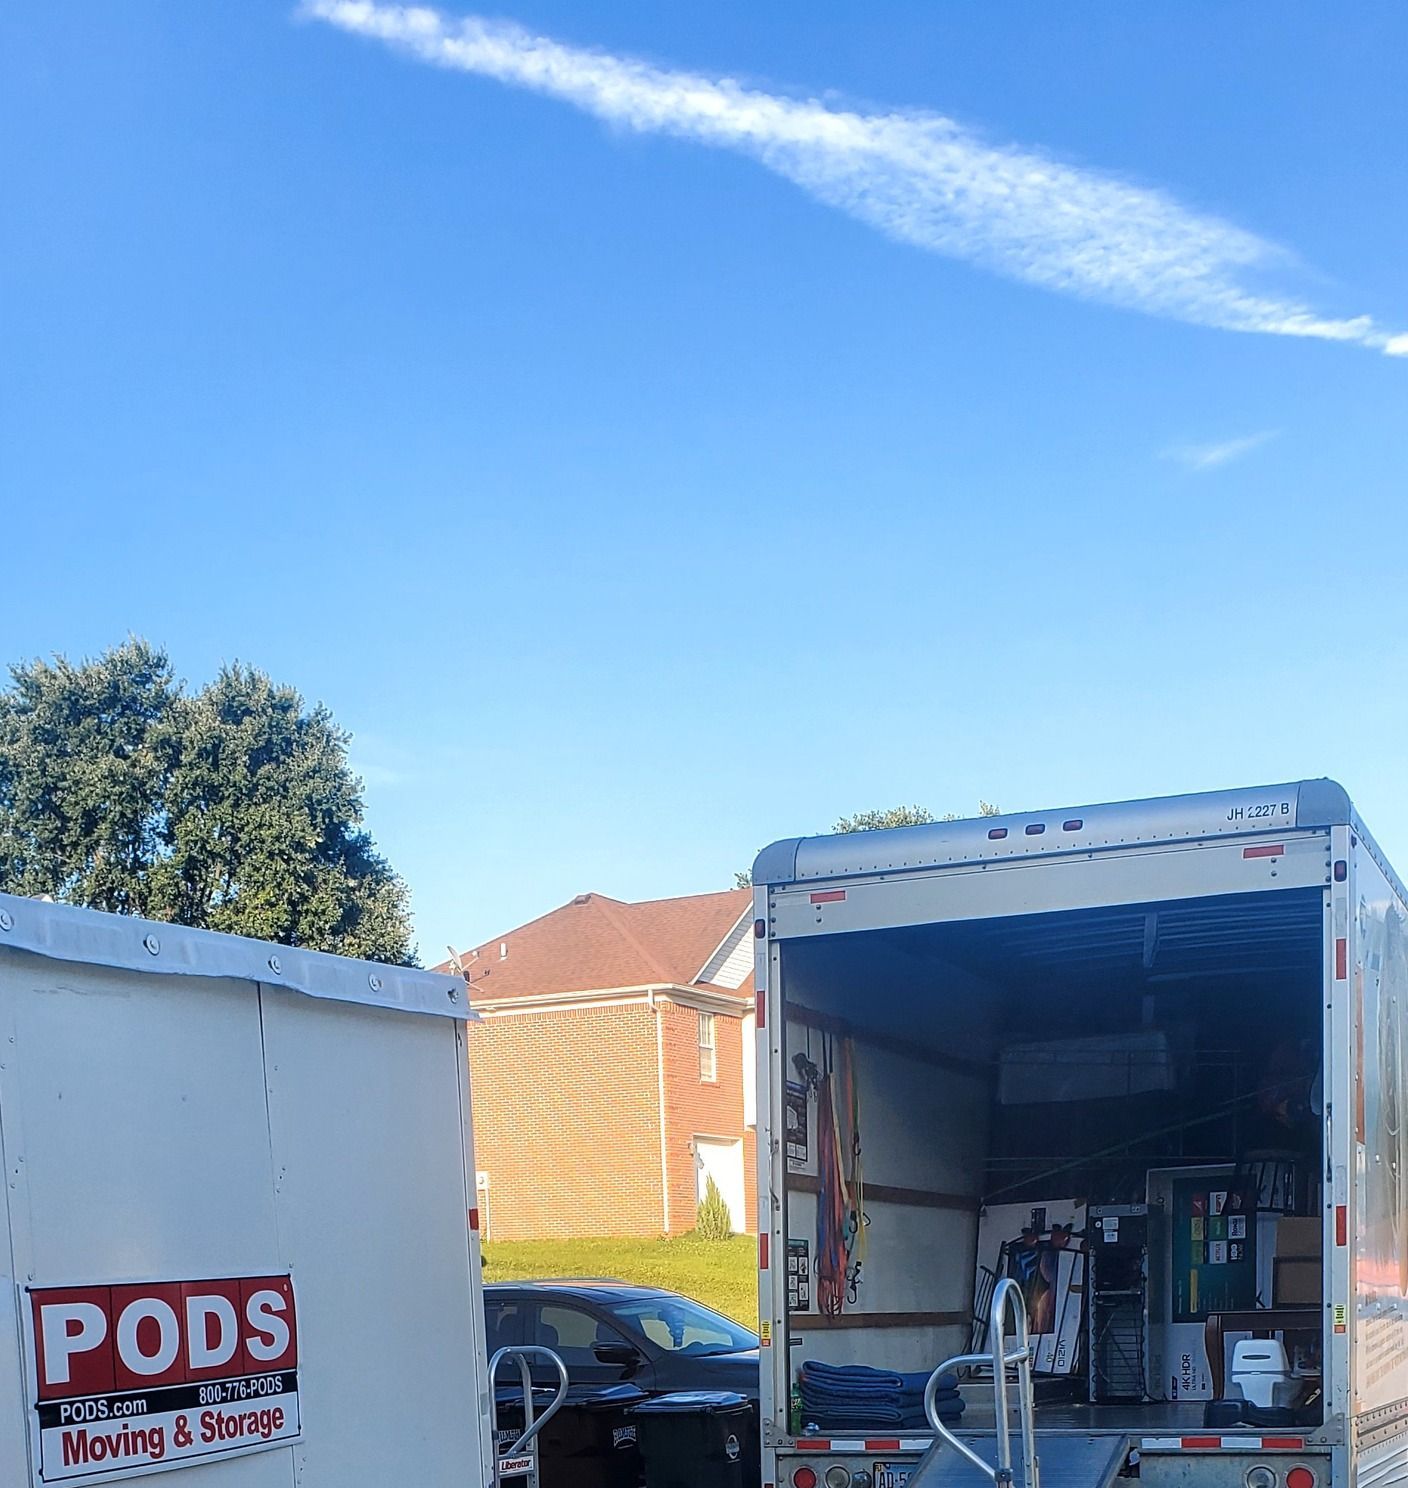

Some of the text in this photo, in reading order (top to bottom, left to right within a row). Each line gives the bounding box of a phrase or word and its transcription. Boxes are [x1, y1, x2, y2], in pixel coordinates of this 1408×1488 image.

[1227, 802, 1290, 821] JH 2227 B
[40, 1289, 290, 1385] PODS
[1057, 1339, 1067, 1367] VIZIO
[1181, 1354, 1191, 1391] 4K HDR
[60, 1376, 283, 1424] PODS.com 800-776-PODS
[61, 1406, 285, 1467] Moving & Storage
[501, 1459, 531, 1470] Liberator
